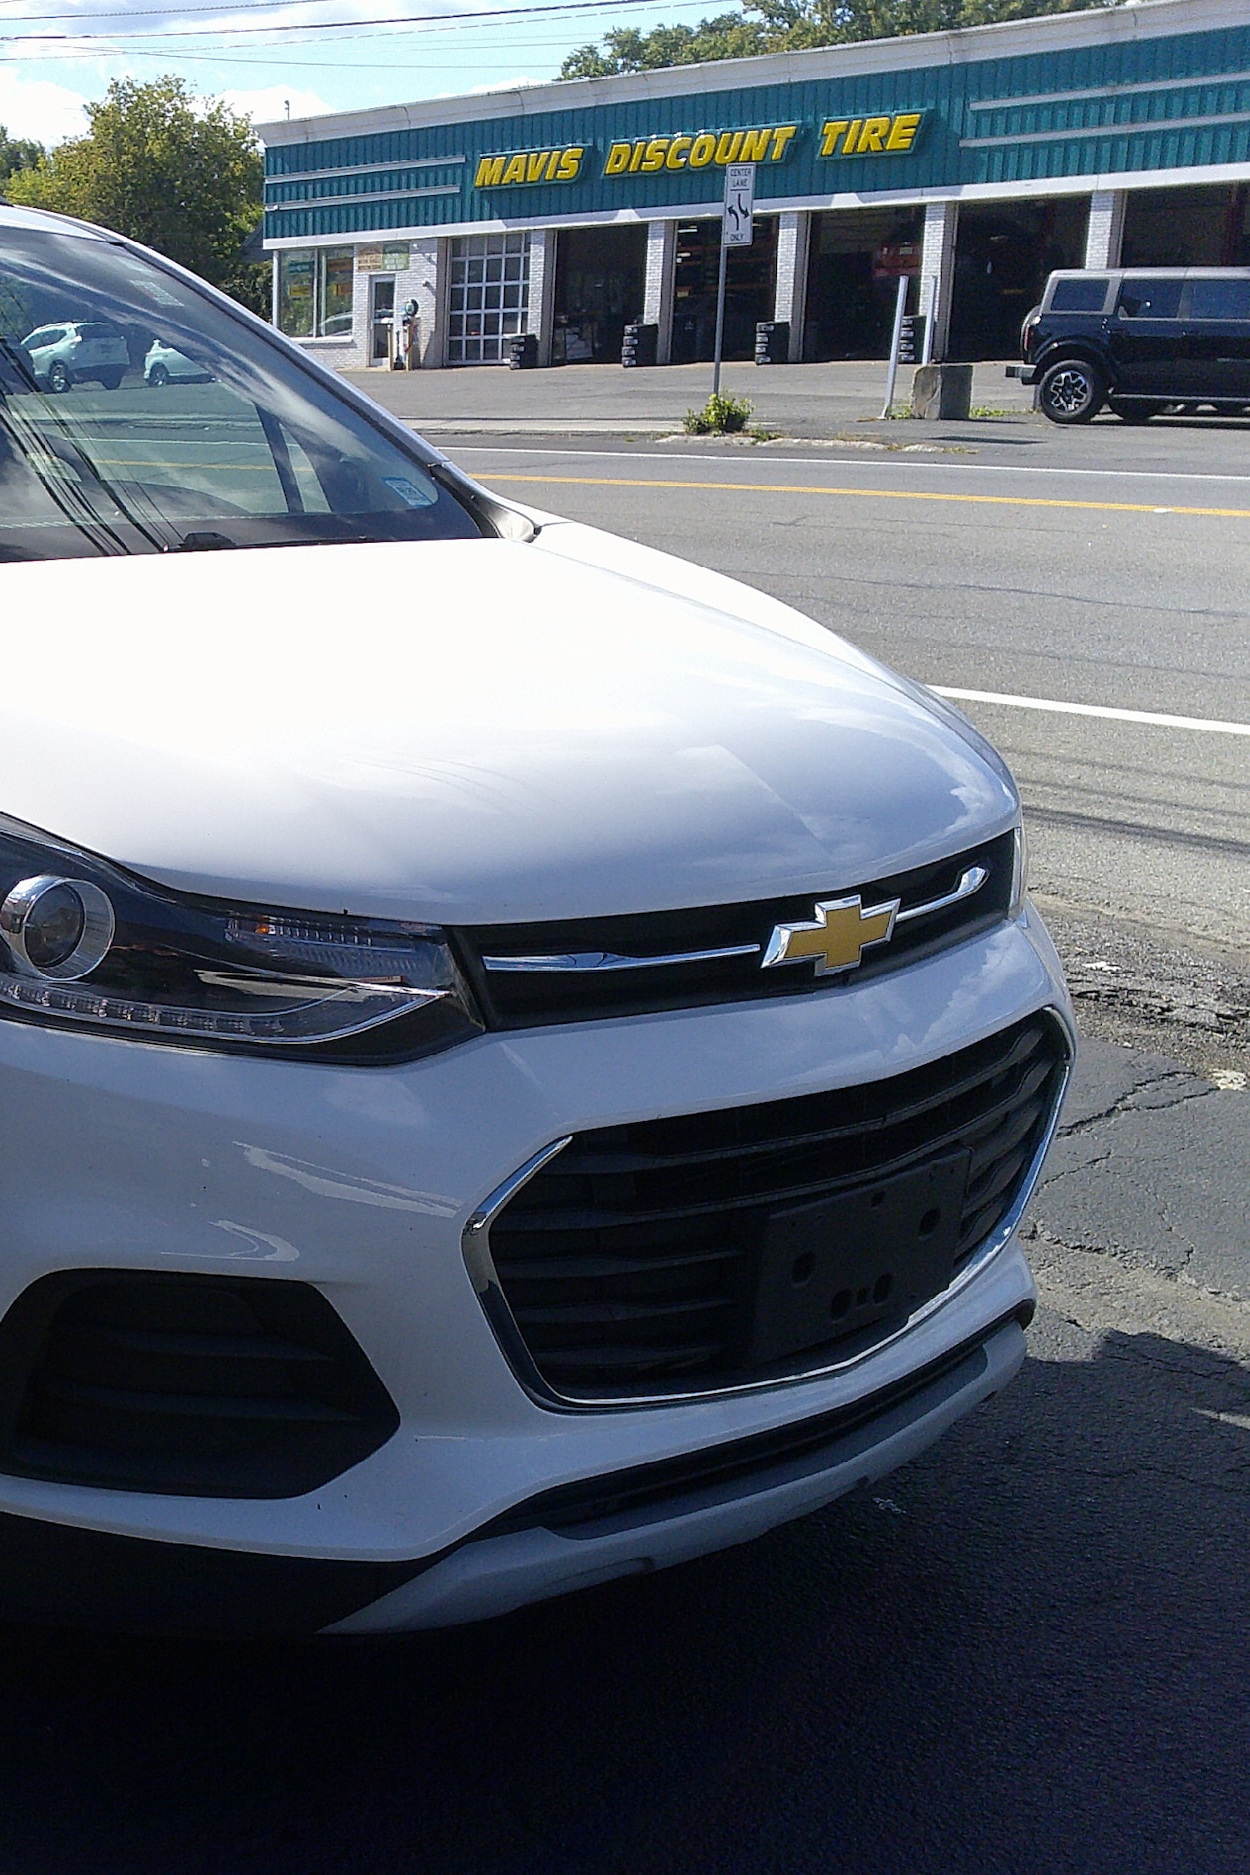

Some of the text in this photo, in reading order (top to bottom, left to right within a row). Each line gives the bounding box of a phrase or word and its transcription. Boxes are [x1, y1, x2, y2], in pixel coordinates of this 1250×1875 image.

[475, 113, 922, 188] MAVIS DISCOUNT TIRE
[731, 168, 751, 177] CENTER
[733, 179, 748, 187] LANE
